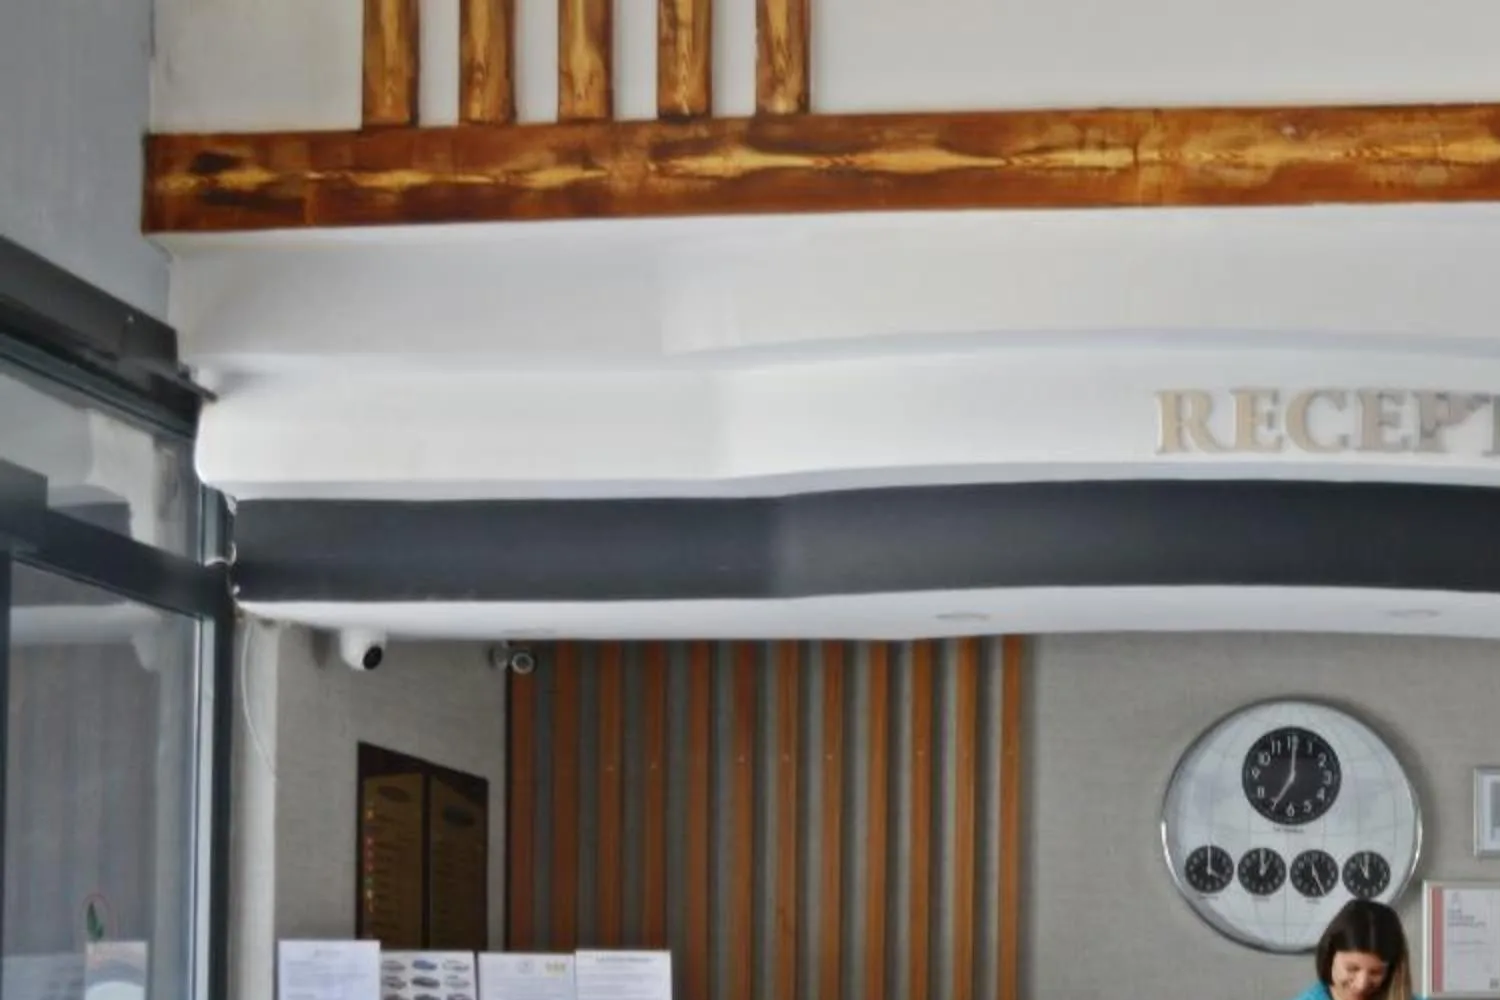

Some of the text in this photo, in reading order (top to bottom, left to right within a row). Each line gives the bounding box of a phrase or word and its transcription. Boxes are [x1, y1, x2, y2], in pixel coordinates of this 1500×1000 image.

[1271, 739, 1281, 755] 11
[1258, 751, 1271, 767] 10
[1317, 751, 1327, 768] 2
[1322, 769, 1333, 785] 3
[1316, 786, 1325, 801] 4
[1286, 803, 1295, 817] 6
